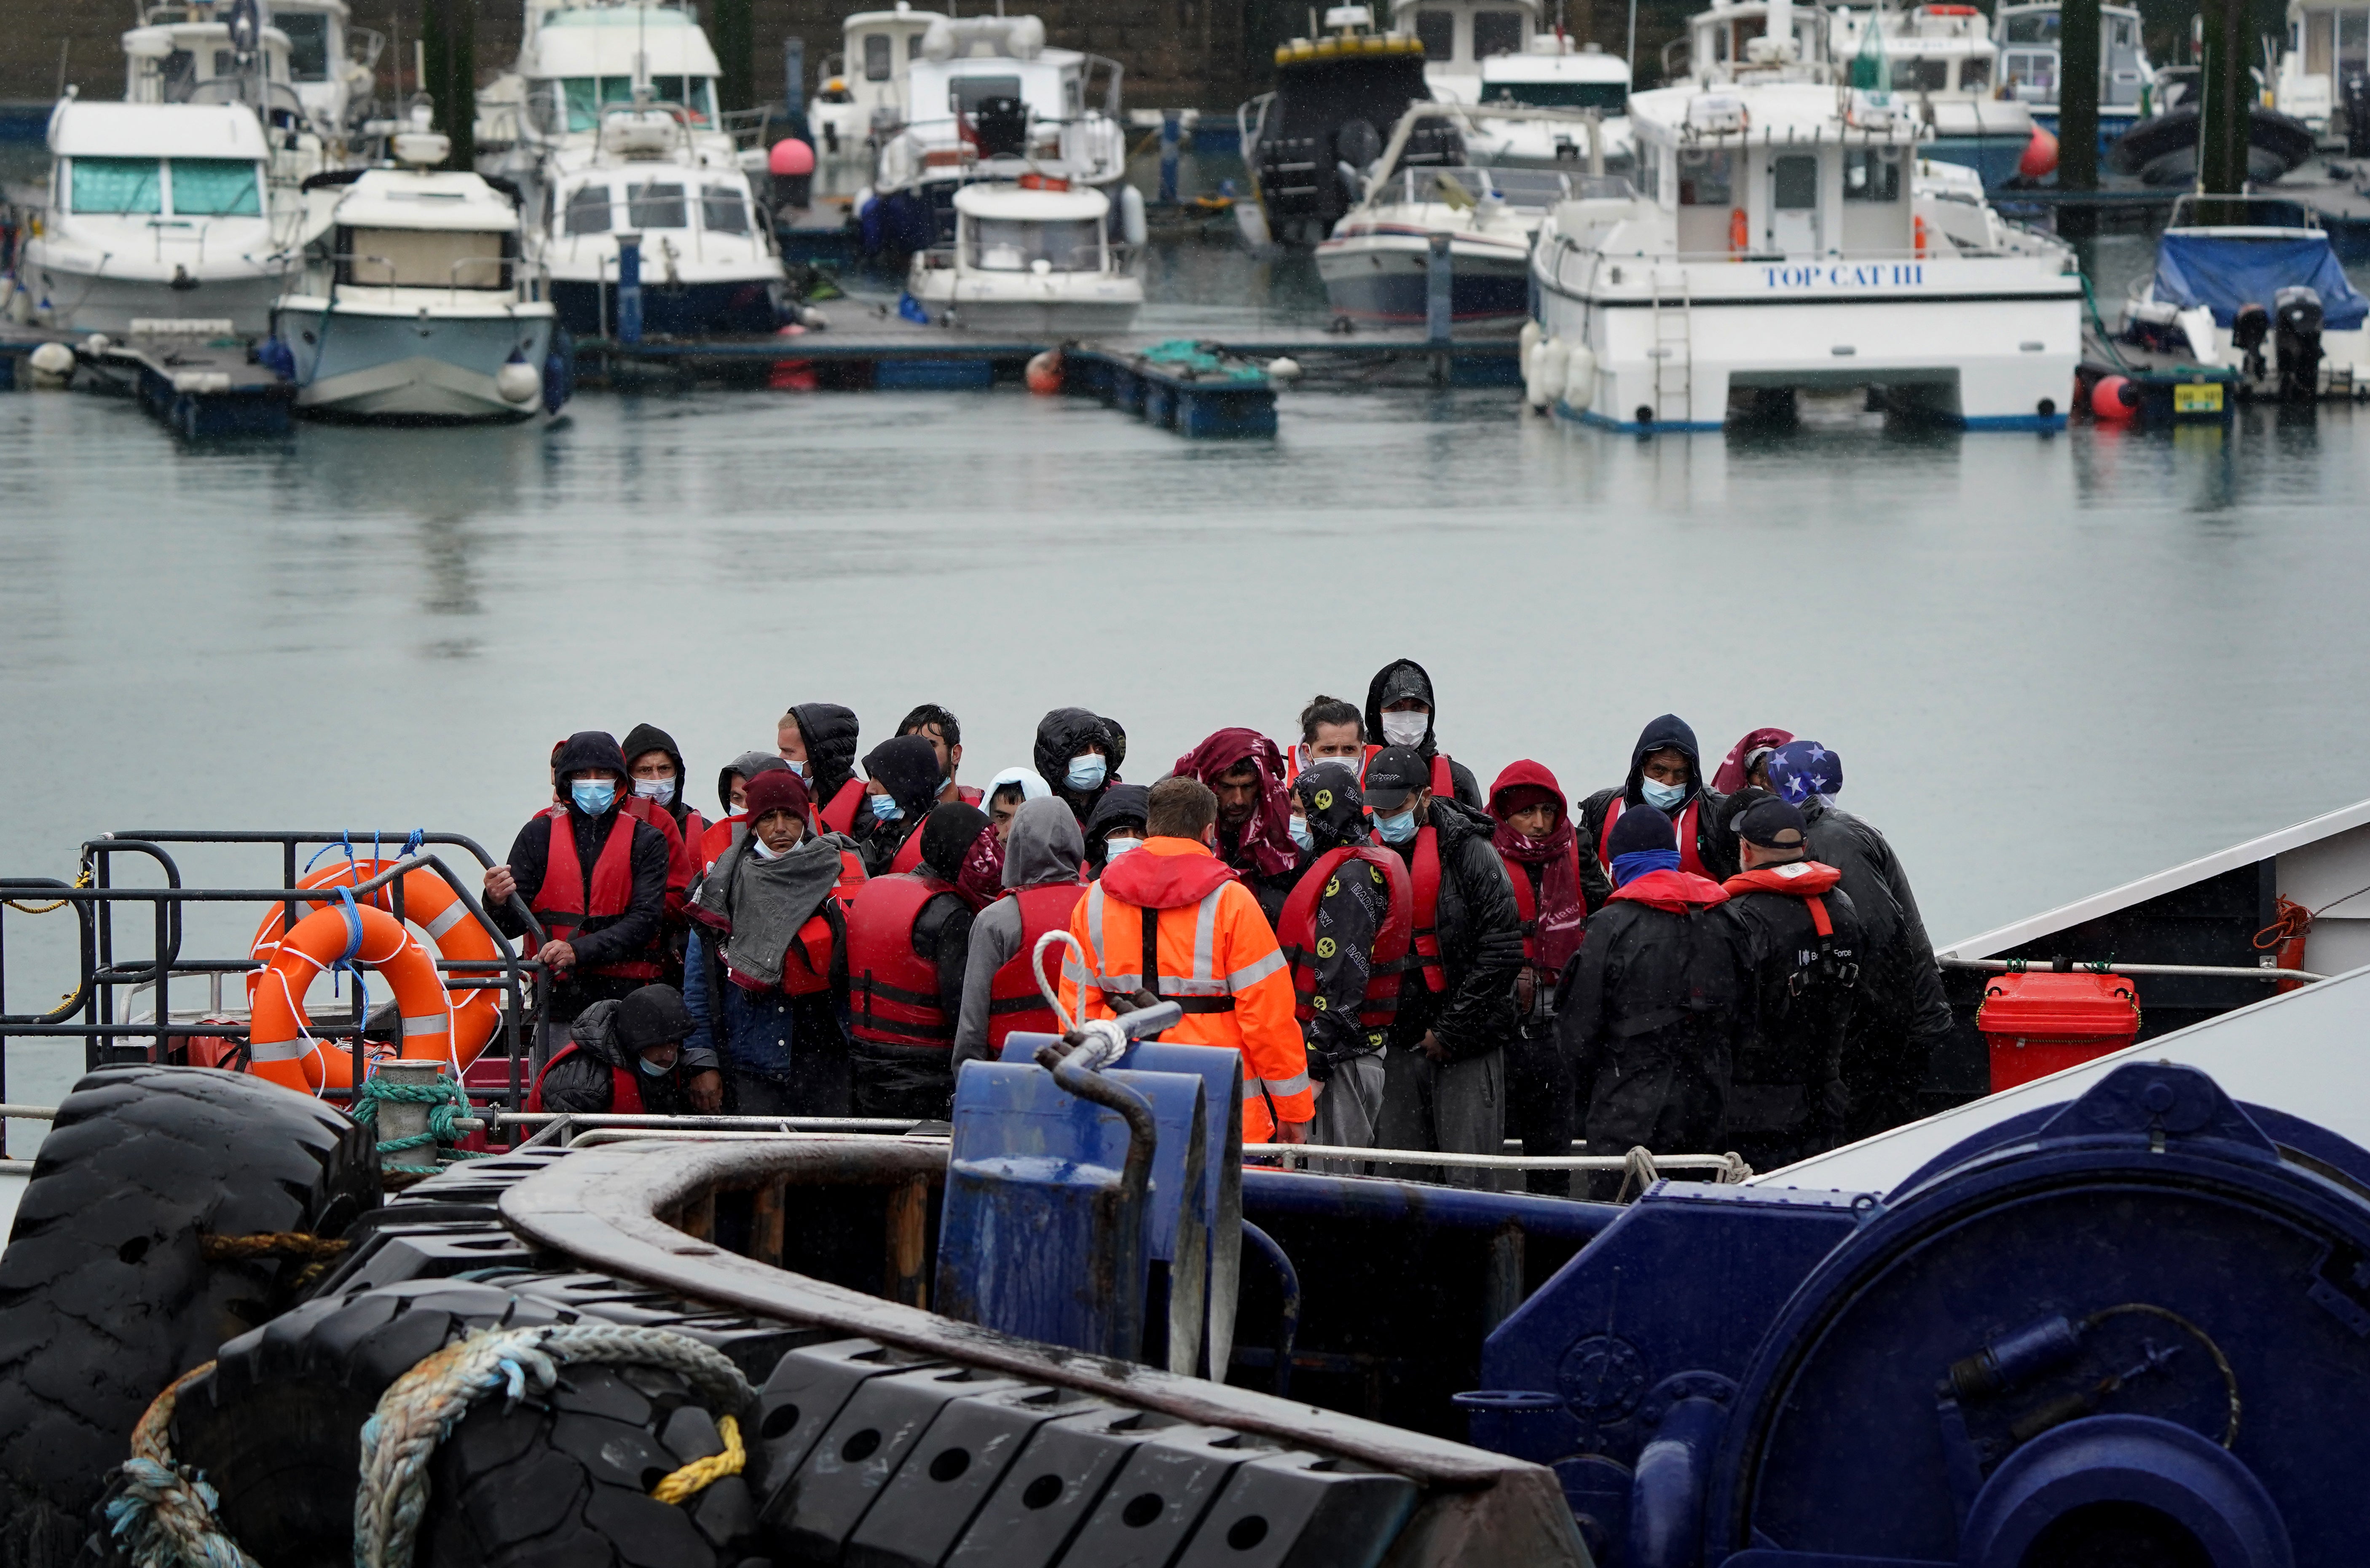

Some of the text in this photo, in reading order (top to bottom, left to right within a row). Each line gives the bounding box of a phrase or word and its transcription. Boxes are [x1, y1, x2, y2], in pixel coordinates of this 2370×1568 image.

[1761, 265, 1922, 288] TOP CAT III
[1351, 882, 1376, 928] BARRO
